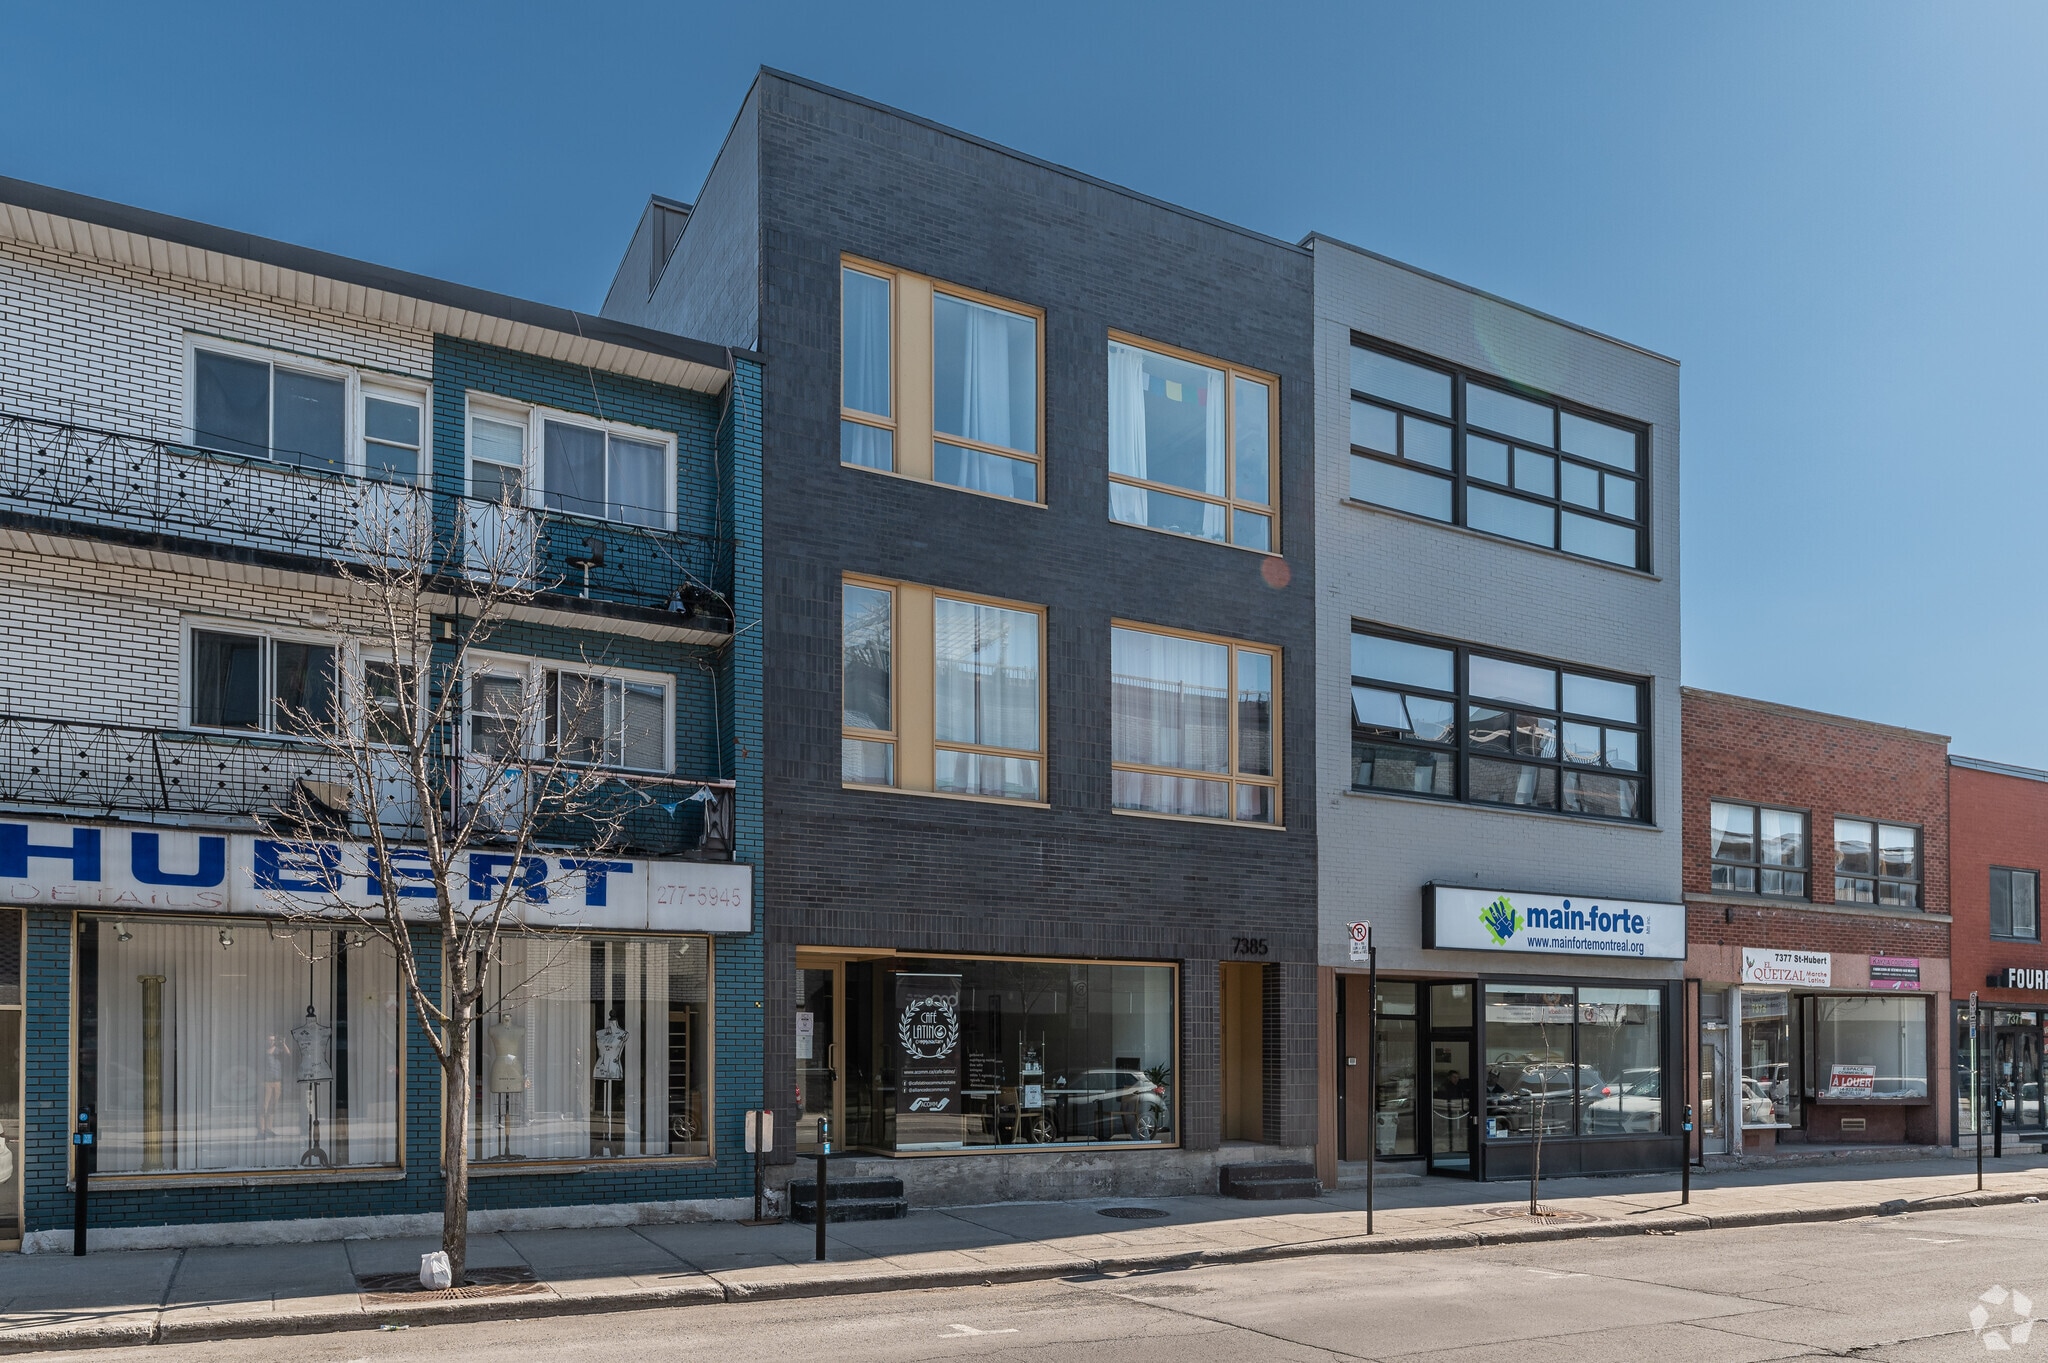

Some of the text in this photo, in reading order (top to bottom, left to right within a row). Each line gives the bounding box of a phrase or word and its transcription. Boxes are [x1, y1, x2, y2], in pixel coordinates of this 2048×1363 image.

[0, 823, 633, 907] HUBERT
[657, 885, 741, 908] 277-5945
[1527, 899, 1645, 935] main-forte
[1231, 936, 1269, 956] 7385
[1527, 936, 1645, 956] www.mainfortemontreal.org
[1763, 961, 1772, 969] EL
[1775, 953, 1828, 965] 7377 St-Hubert
[1753, 967, 1806, 982] QUETZAL
[913, 1025, 946, 1039] LATINO
[1841, 1077, 1871, 1087] LOUER
